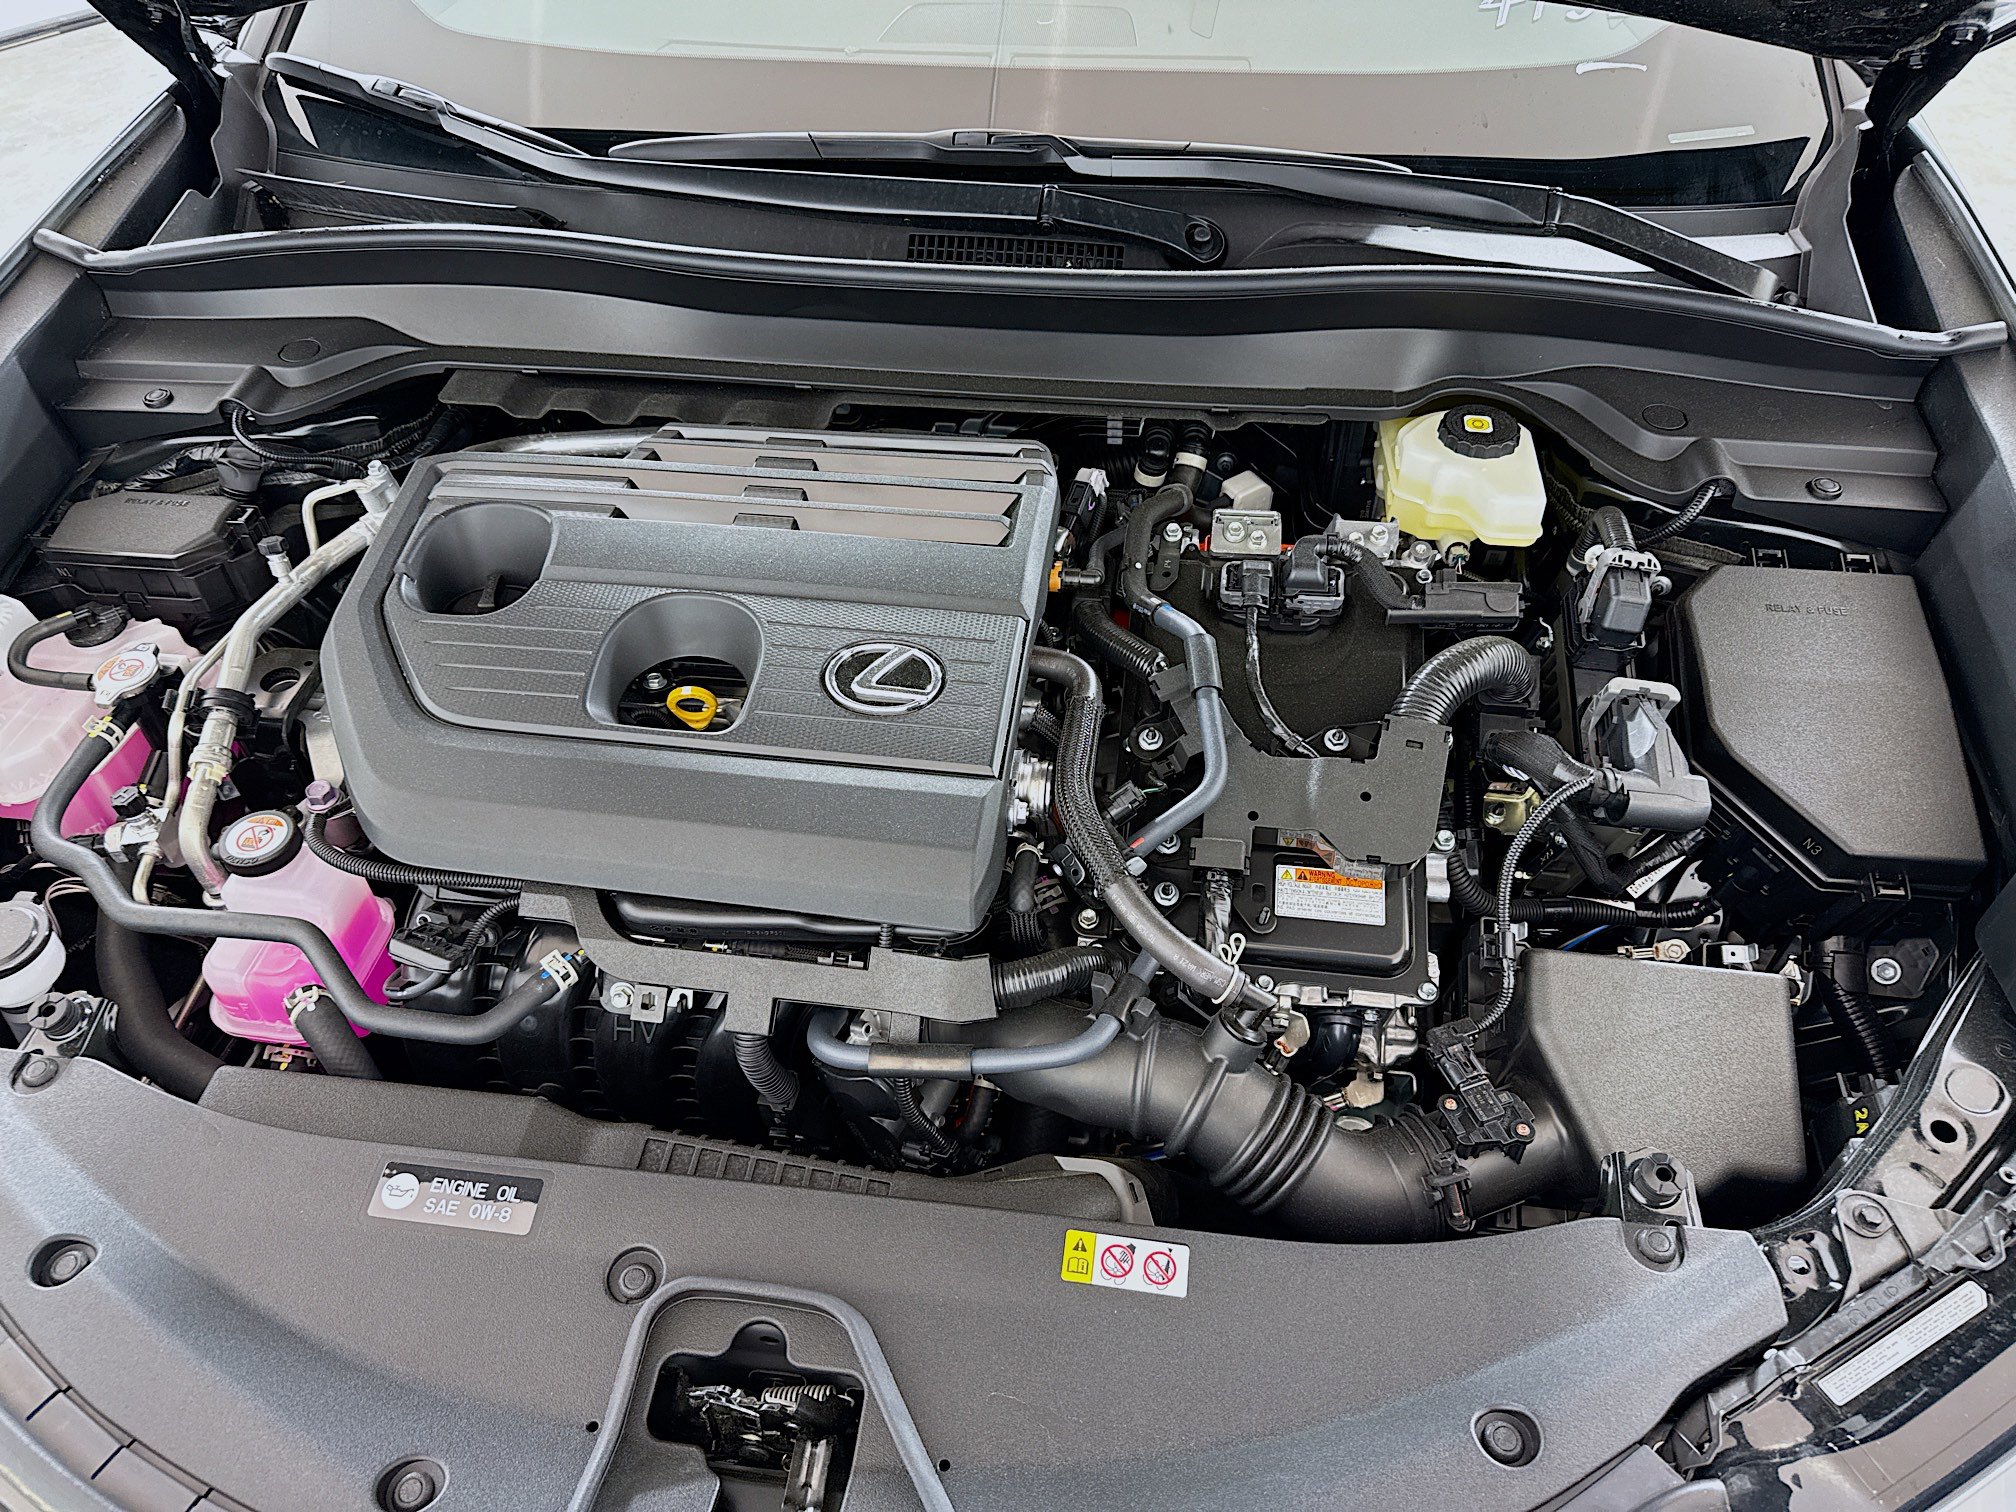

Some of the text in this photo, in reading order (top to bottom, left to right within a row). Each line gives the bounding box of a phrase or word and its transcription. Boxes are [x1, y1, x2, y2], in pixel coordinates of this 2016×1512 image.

[1765, 603, 1848, 616] RELAY & FUSE
[1802, 837, 1823, 855] N3
[1309, 870, 1336, 879] WARNING
[614, 1015, 656, 1043] HV
[429, 1177, 521, 1204] ENGINE OIL
[423, 1198, 513, 1224] SAE 0W-8
